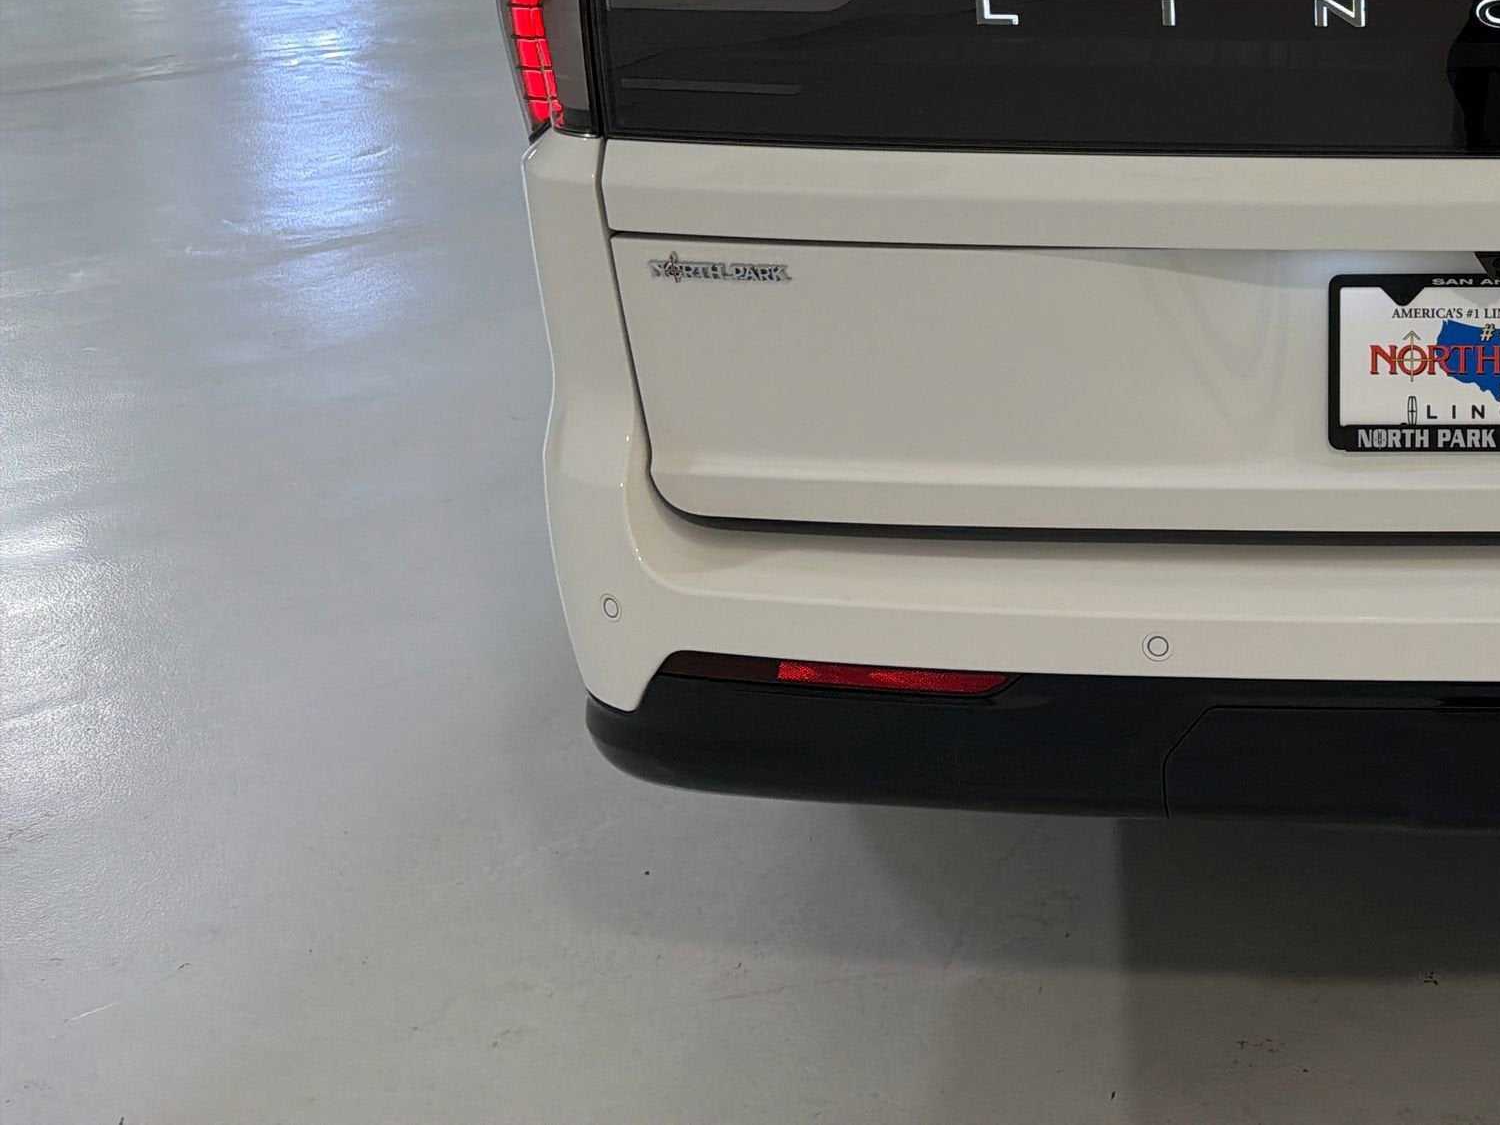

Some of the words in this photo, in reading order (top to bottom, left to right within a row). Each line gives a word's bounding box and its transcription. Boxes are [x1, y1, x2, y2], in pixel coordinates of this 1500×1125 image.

[731, 264, 792, 282] PARK
[1432, 278, 1474, 286] SAN
[1391, 307, 1464, 319] AMERICA'S
[1466, 307, 1480, 319] #1
[1357, 428, 1429, 448] NORTH
[1437, 428, 1497, 448] PARK
